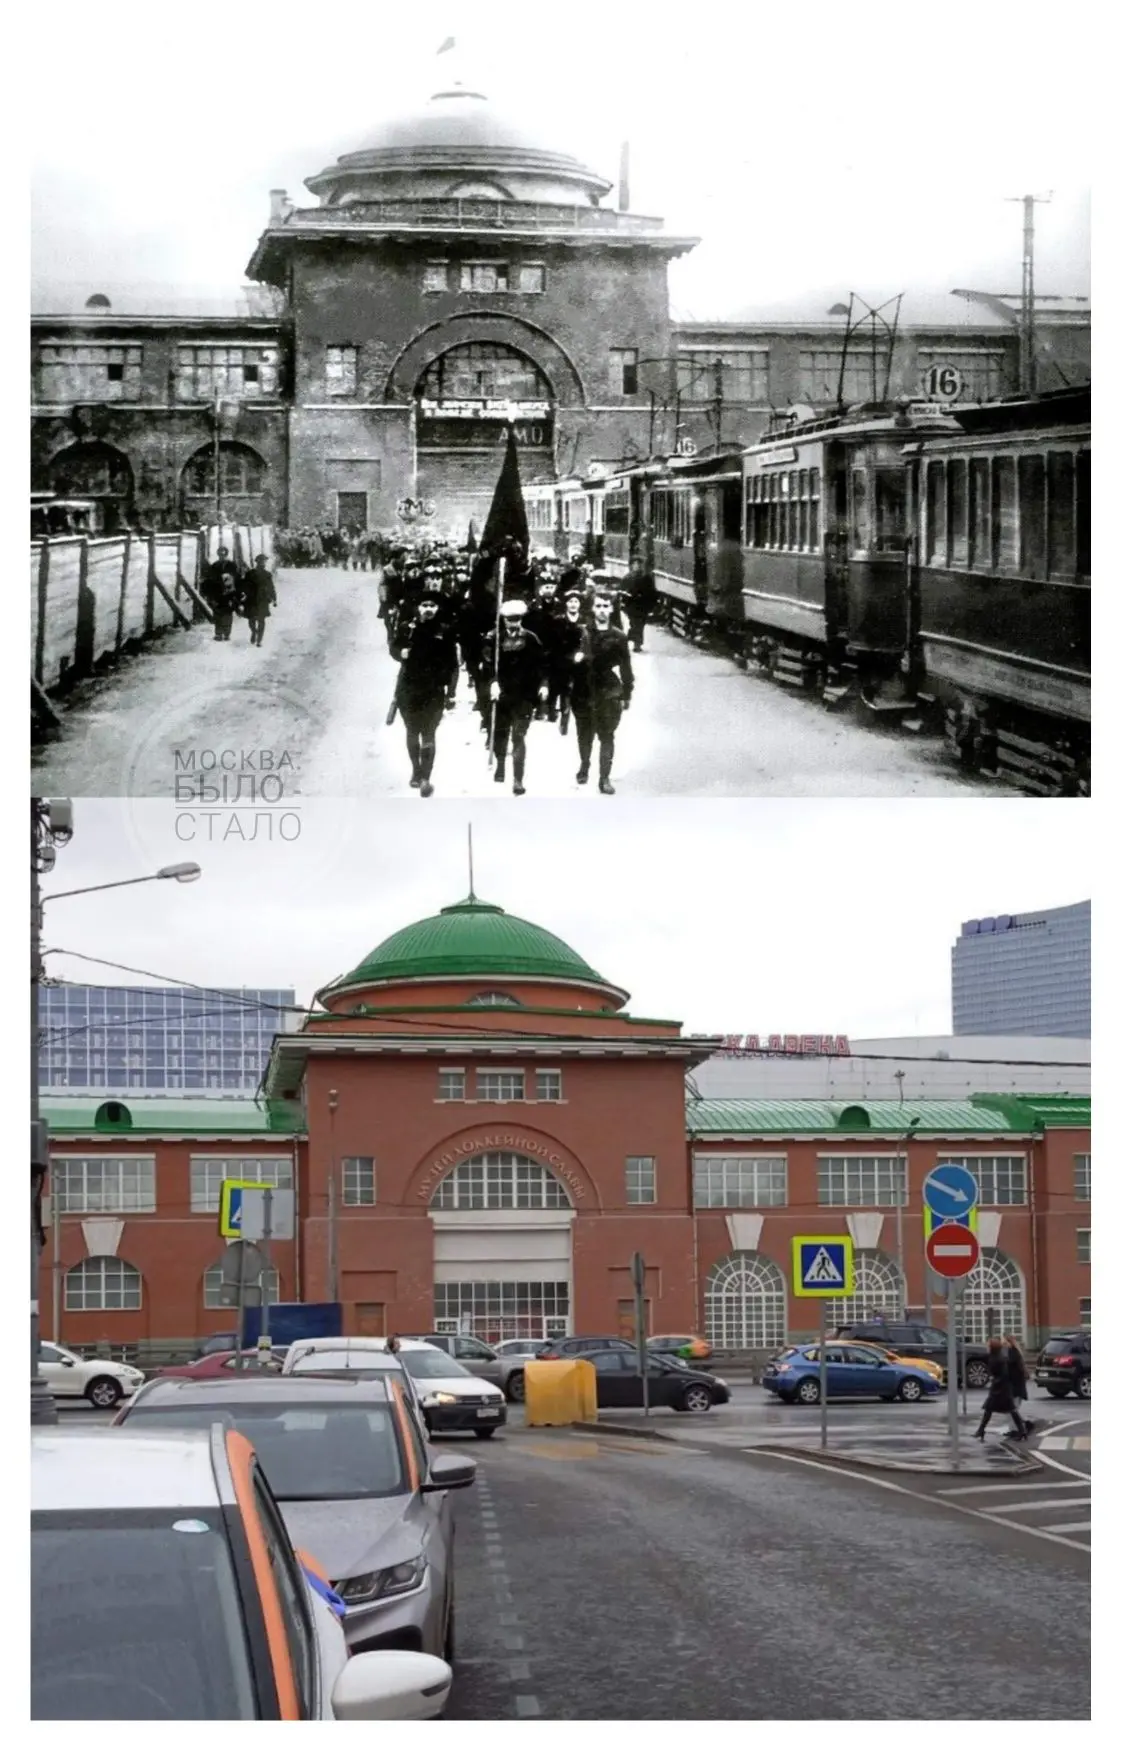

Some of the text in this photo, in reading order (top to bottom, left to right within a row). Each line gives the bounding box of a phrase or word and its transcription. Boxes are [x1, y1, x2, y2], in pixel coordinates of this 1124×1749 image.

[929, 368, 957, 396] 16
[680, 440, 695, 454] 16
[768, 1034, 851, 1058] АРЕНА
[417, 1134, 587, 1201] МУЗЕЙ ХОККЕЙНОЙ СЛАВЫ
